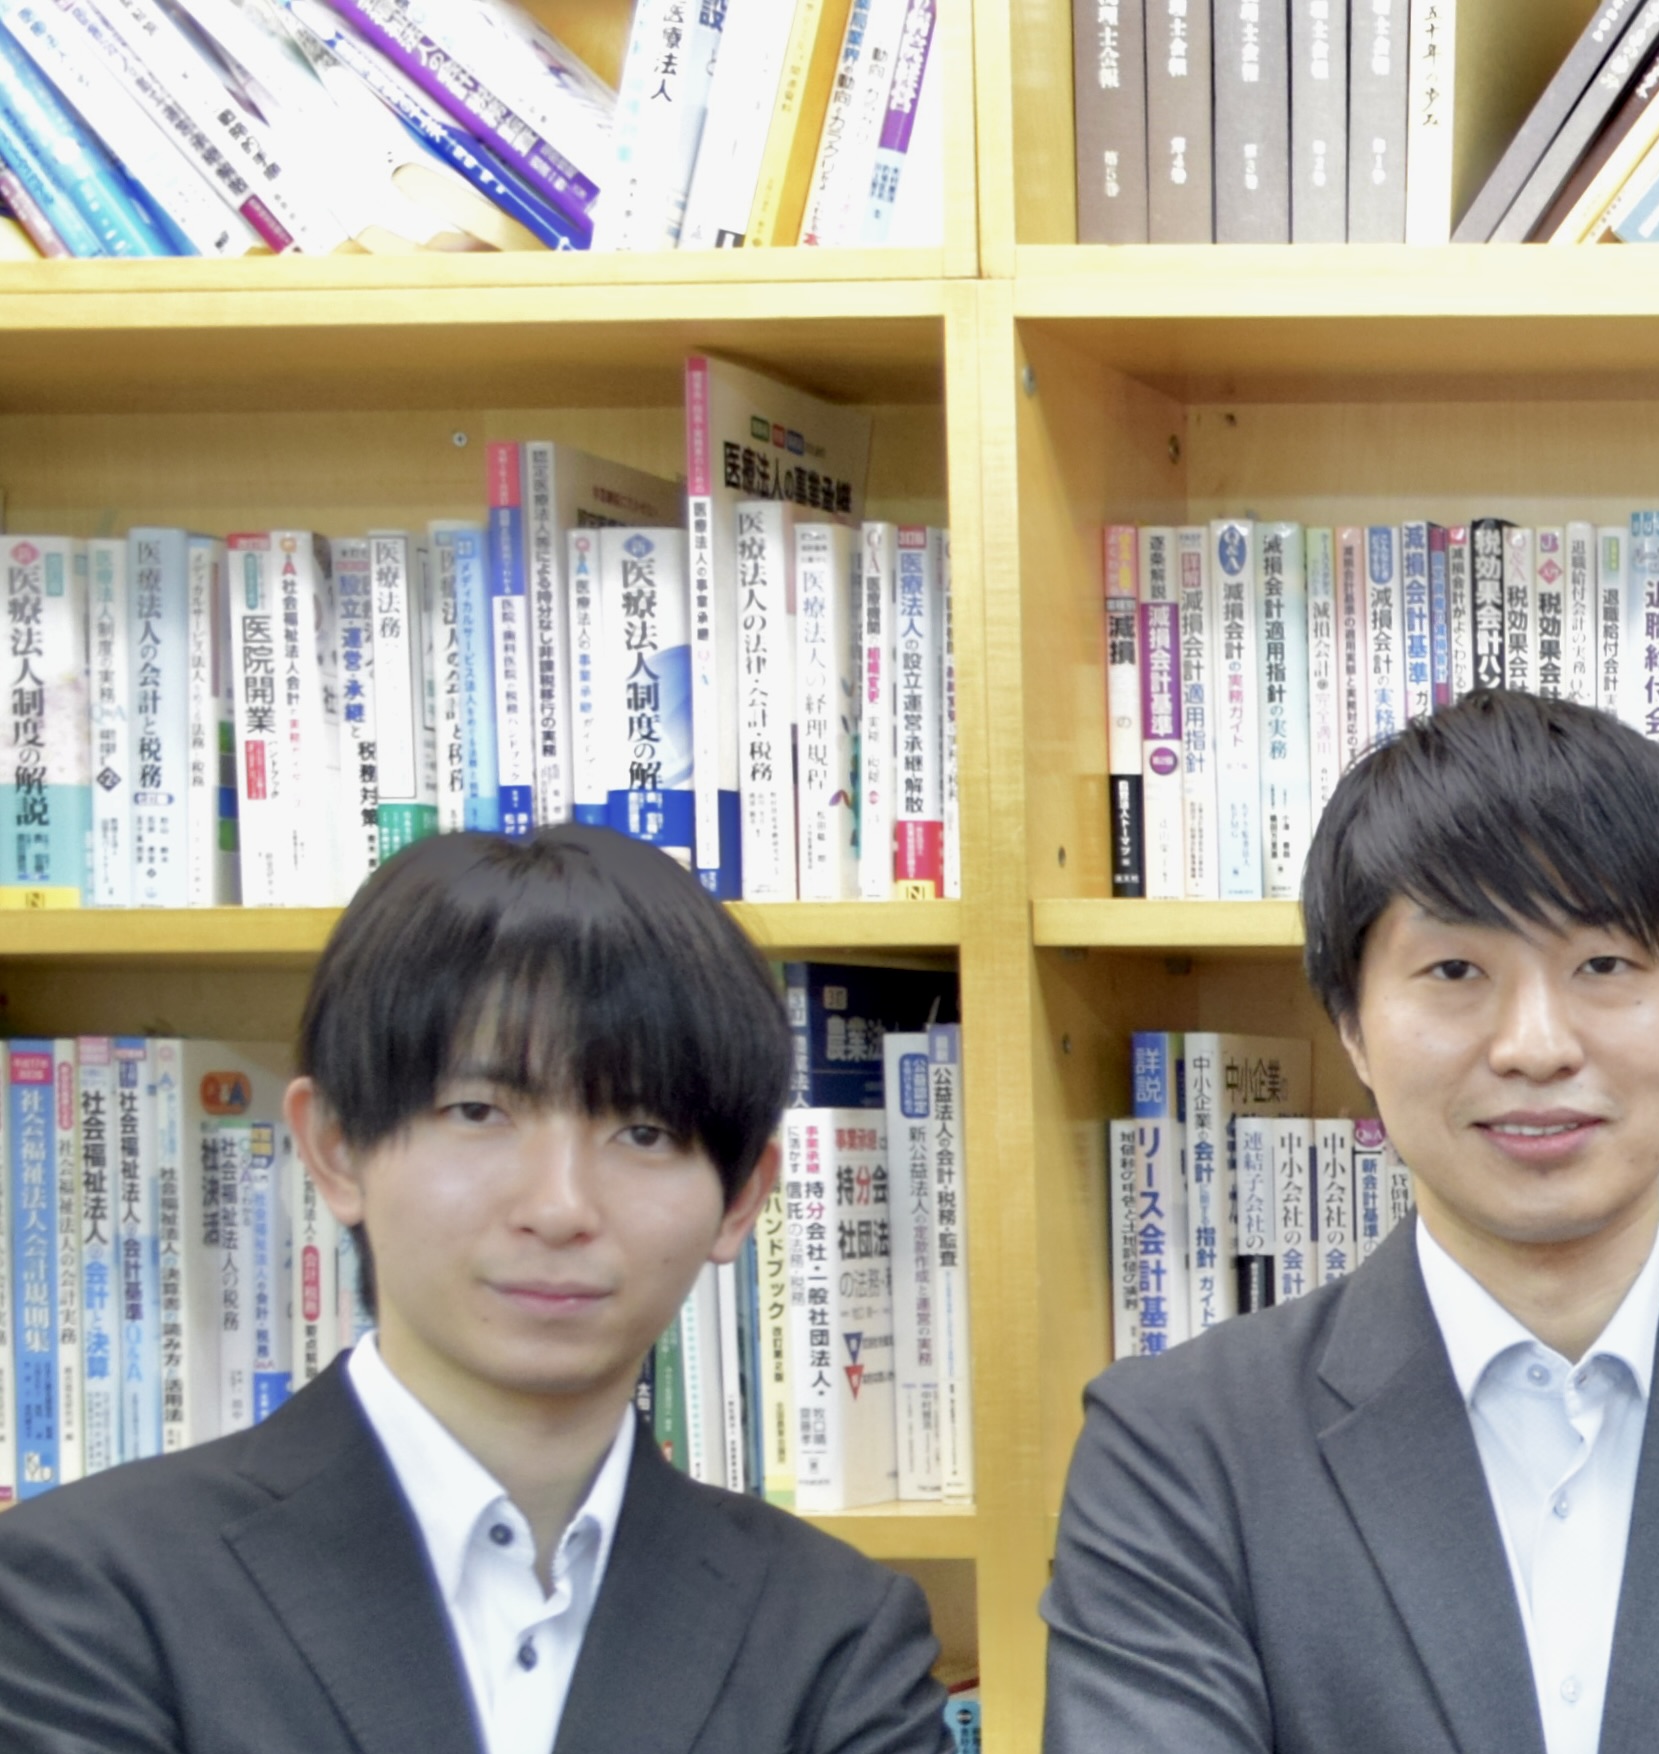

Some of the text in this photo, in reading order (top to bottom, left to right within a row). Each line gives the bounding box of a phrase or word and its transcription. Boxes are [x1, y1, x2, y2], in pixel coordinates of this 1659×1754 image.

[7, 565, 50, 828] 医療法人制度の解説
[137, 540, 163, 789] 医療法人の会計と税務
[242, 615, 276, 735] 医院開業
[1108, 615, 1136, 666] 減損
[1181, 590, 1206, 774] 減損会計適用指針
[1222, 582, 1246, 748] 減損会計の実務ガイド
[1263, 534, 1287, 760] 減損会計適用指針の実務
[933, 1067, 960, 1267] 公益法人の会計・税務・監査
[1136, 1047, 1164, 1104] 詳説
[20, 1089, 50, 1354] 社会福祉法人会計規則集
[57, 1138, 77, 1345] 社会福祉法人の会計実務
[80, 1089, 110, 1381] 社会福祉法人の会計と決算
[220, 1136, 241, 1333] 社会福祉法人の税務
[786, 1179, 806, 1308] 信託の法務・税務
[805, 1180, 832, 1397] 持分会社・一般社団法人・
[908, 1125, 933, 1367] 新公益法人の定款作成と運営の実務
[1243, 1131, 1265, 1250] 連結子会社の
[1280, 1132, 1305, 1296] 中小会社の会計
